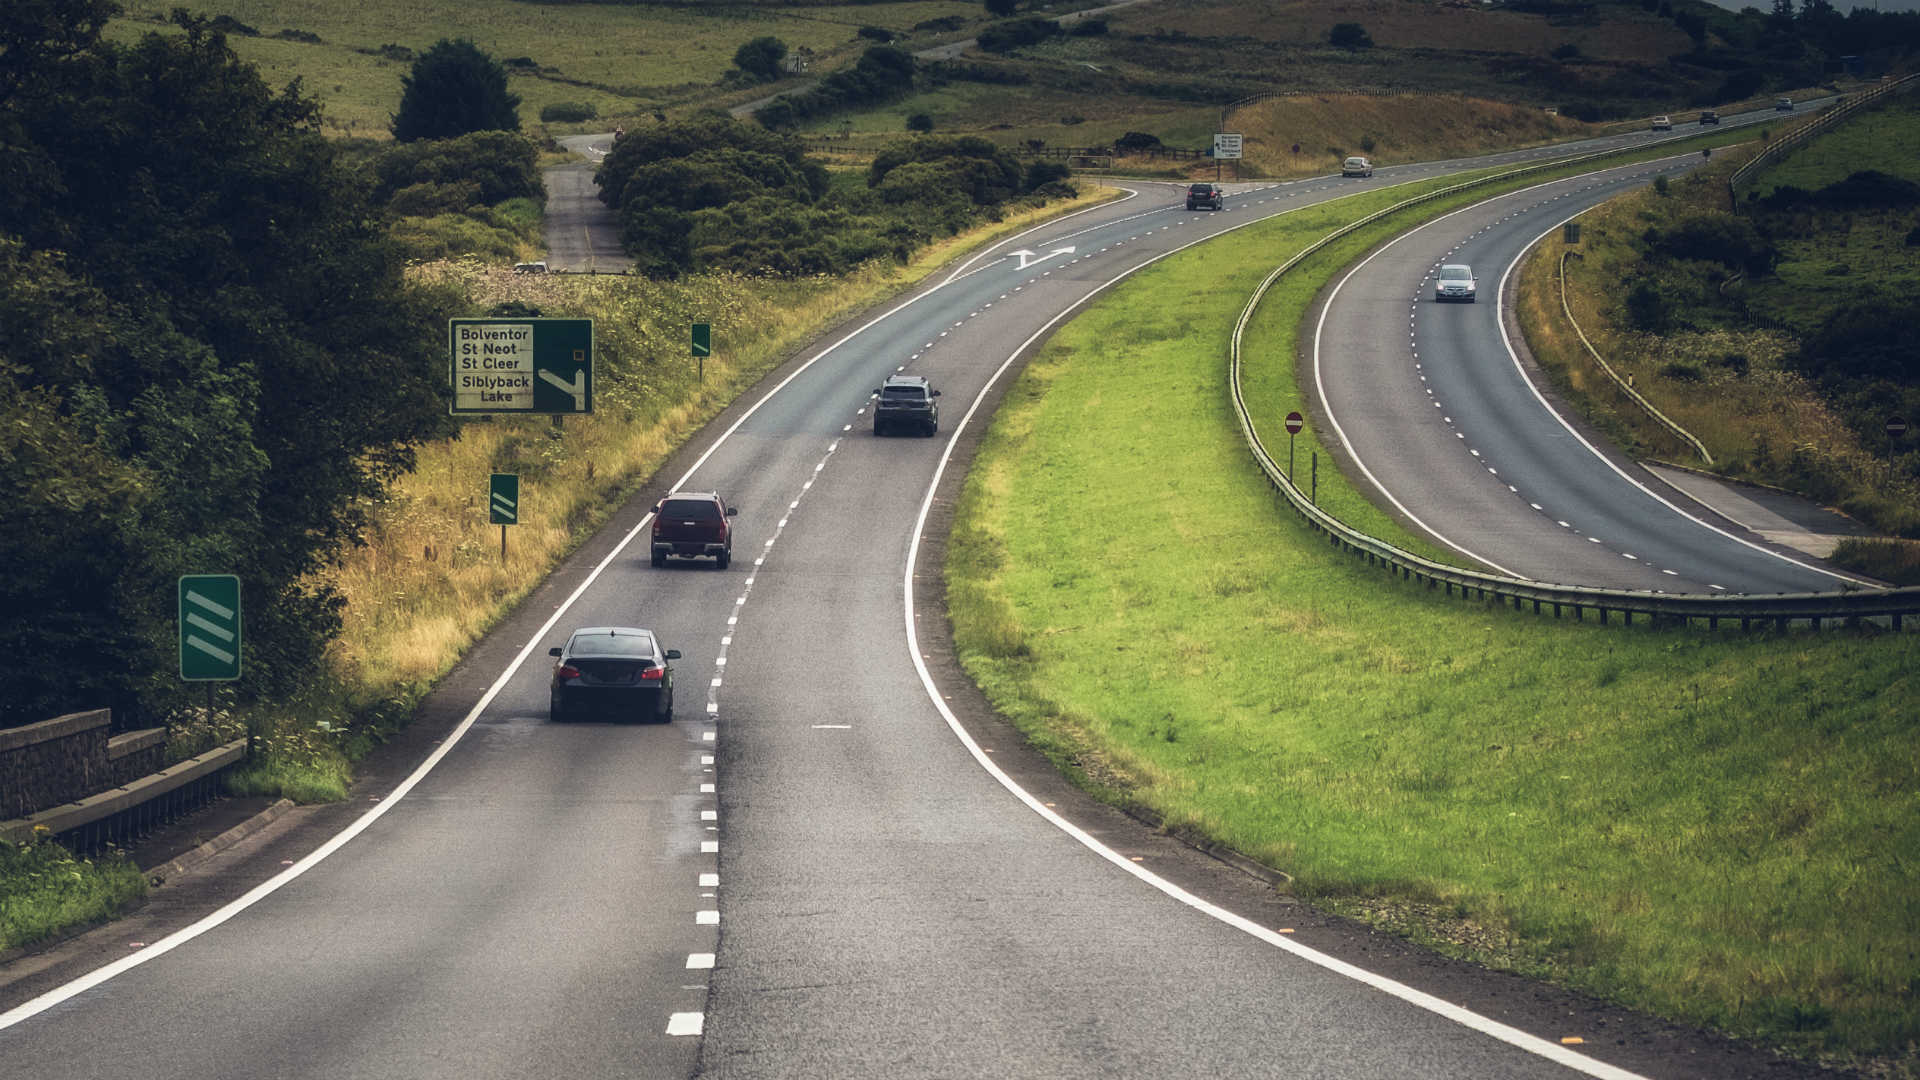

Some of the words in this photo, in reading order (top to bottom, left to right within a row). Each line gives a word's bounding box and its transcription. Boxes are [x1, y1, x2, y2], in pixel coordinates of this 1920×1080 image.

[461, 328, 528, 340] Bolventor
[462, 343, 478, 355] St
[483, 343, 517, 355] Neot
[462, 357, 478, 369] St
[483, 357, 519, 369] Cleer
[462, 376, 529, 389] Siblyback
[481, 390, 513, 402] Lake
